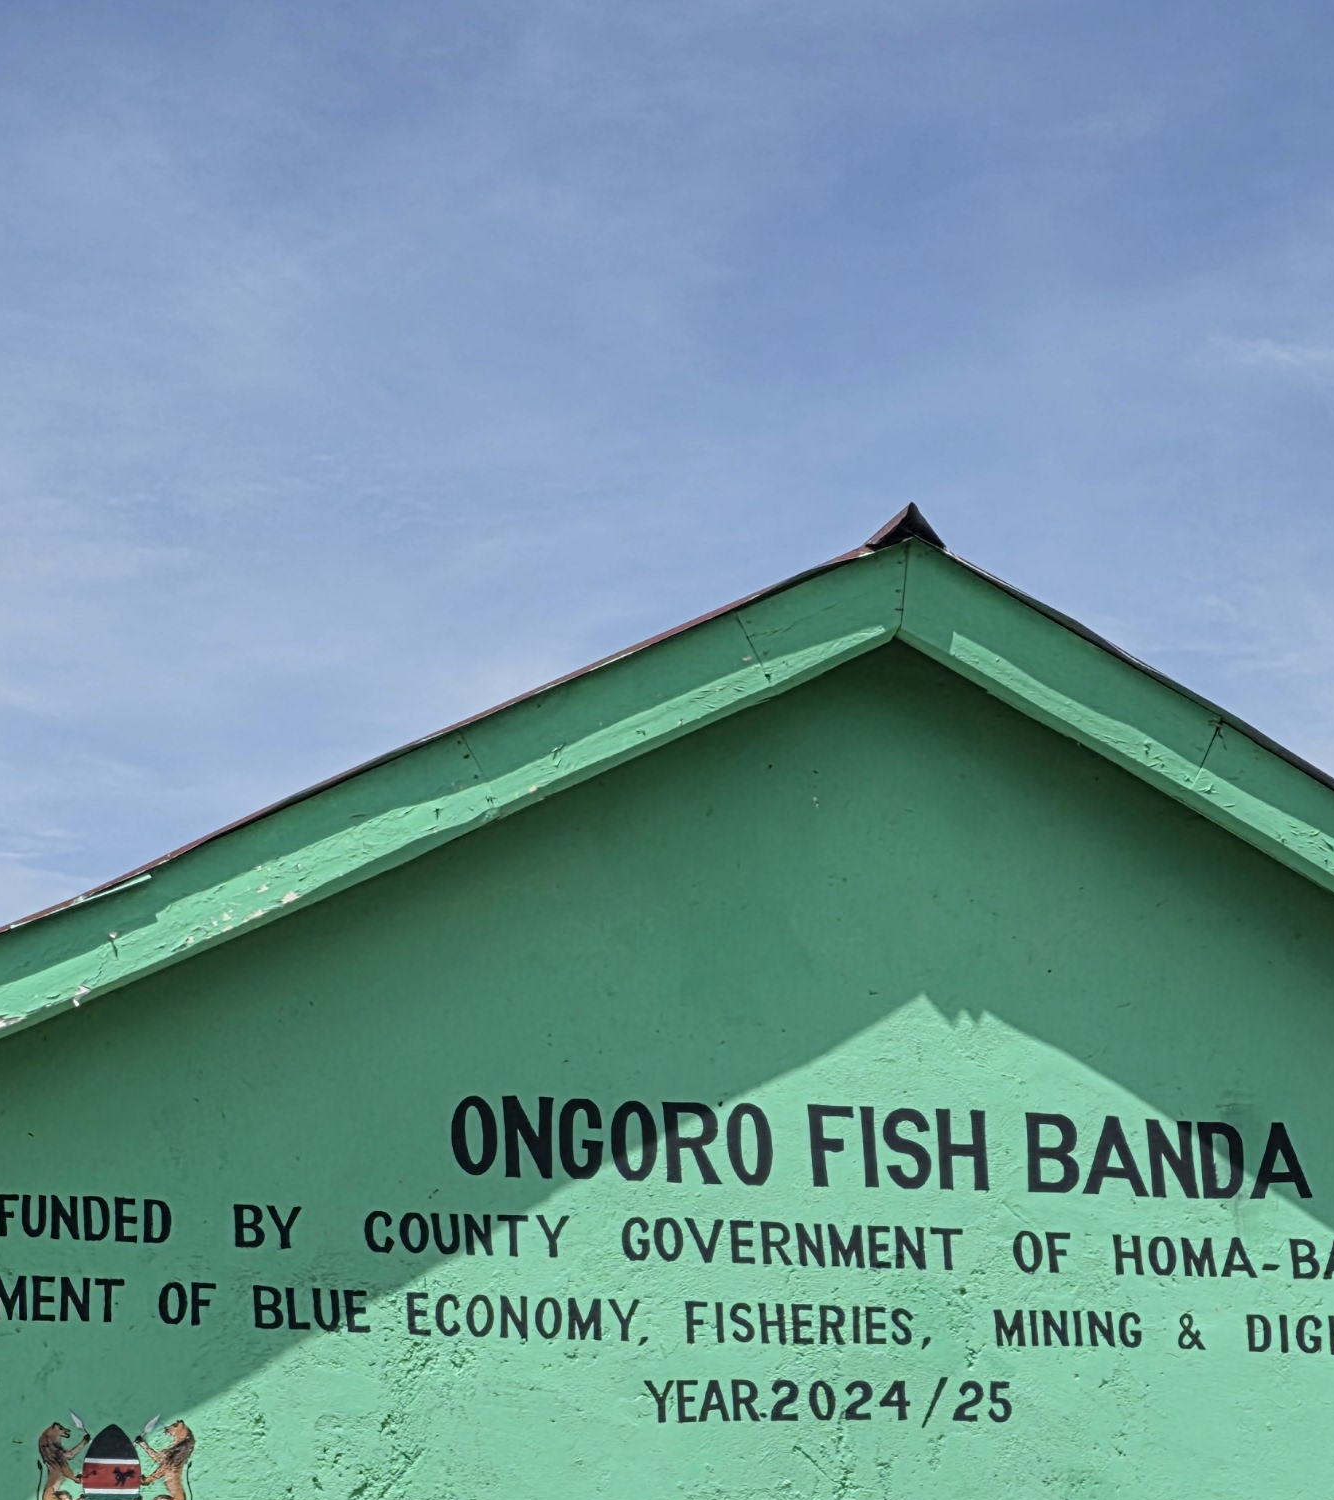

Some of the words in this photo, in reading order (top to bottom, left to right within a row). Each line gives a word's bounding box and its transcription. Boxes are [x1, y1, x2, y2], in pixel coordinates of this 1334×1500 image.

[451, 1095, 773, 1186] ONGORO
[807, 1104, 990, 1192] FISH
[1025, 1112, 1313, 1199] BANDA
[233, 1203, 302, 1250] BY
[621, 1216, 964, 1271] GOVERNMENT
[1012, 1230, 1071, 1274] OF
[158, 1281, 217, 1326] OF
[252, 1284, 371, 1333] BLUE
[406, 1292, 649, 1346] ECONOMY,
[684, 1300, 932, 1350] FISHERIES,
[993, 1309, 1142, 1349] MINING
[1177, 1313, 1207, 1351] &
